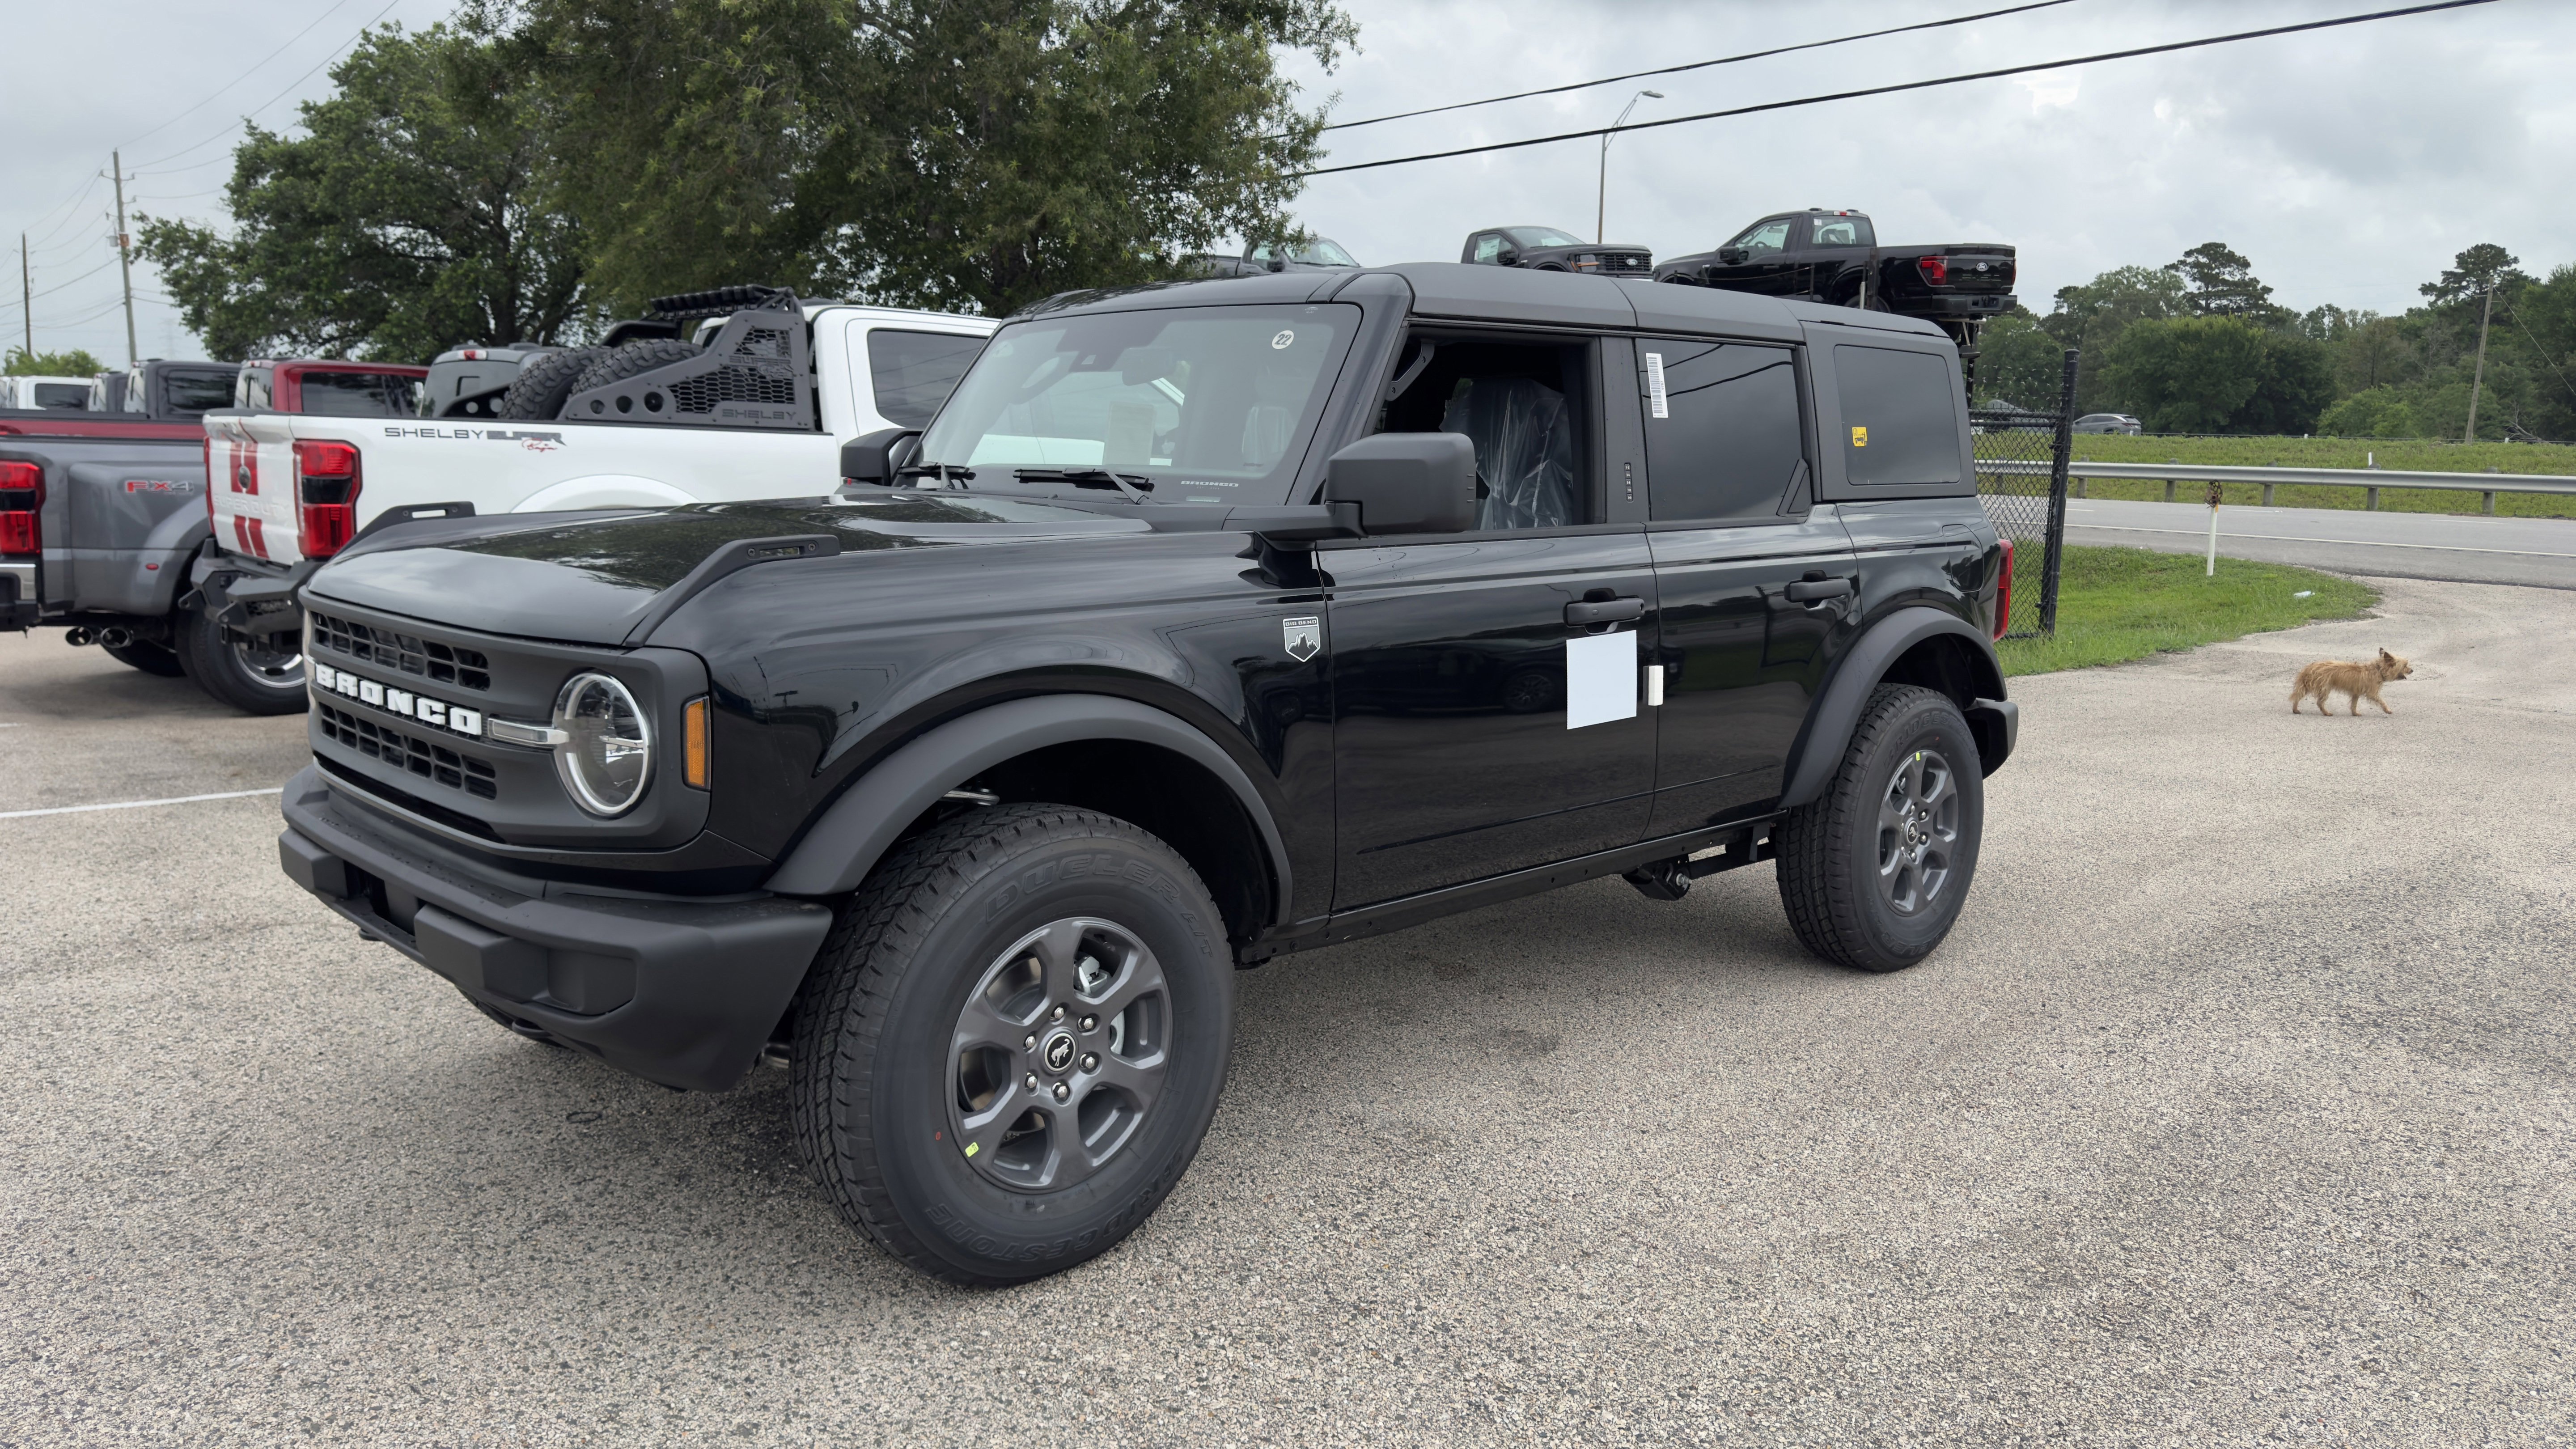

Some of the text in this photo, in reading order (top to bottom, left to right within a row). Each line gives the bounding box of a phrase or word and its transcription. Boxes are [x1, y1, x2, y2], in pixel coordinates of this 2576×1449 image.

[1274, 333, 1292, 346] 22
[722, 409, 796, 420] SHELBY
[385, 427, 484, 440] SHELBY
[125, 480, 194, 493] FX4
[213, 495, 250, 512] SUPER
[315, 664, 482, 736] BRONCO
[983, 854, 1214, 958] DUELER A/T
[924, 1144, 1186, 1262] BRIDGESTONE
